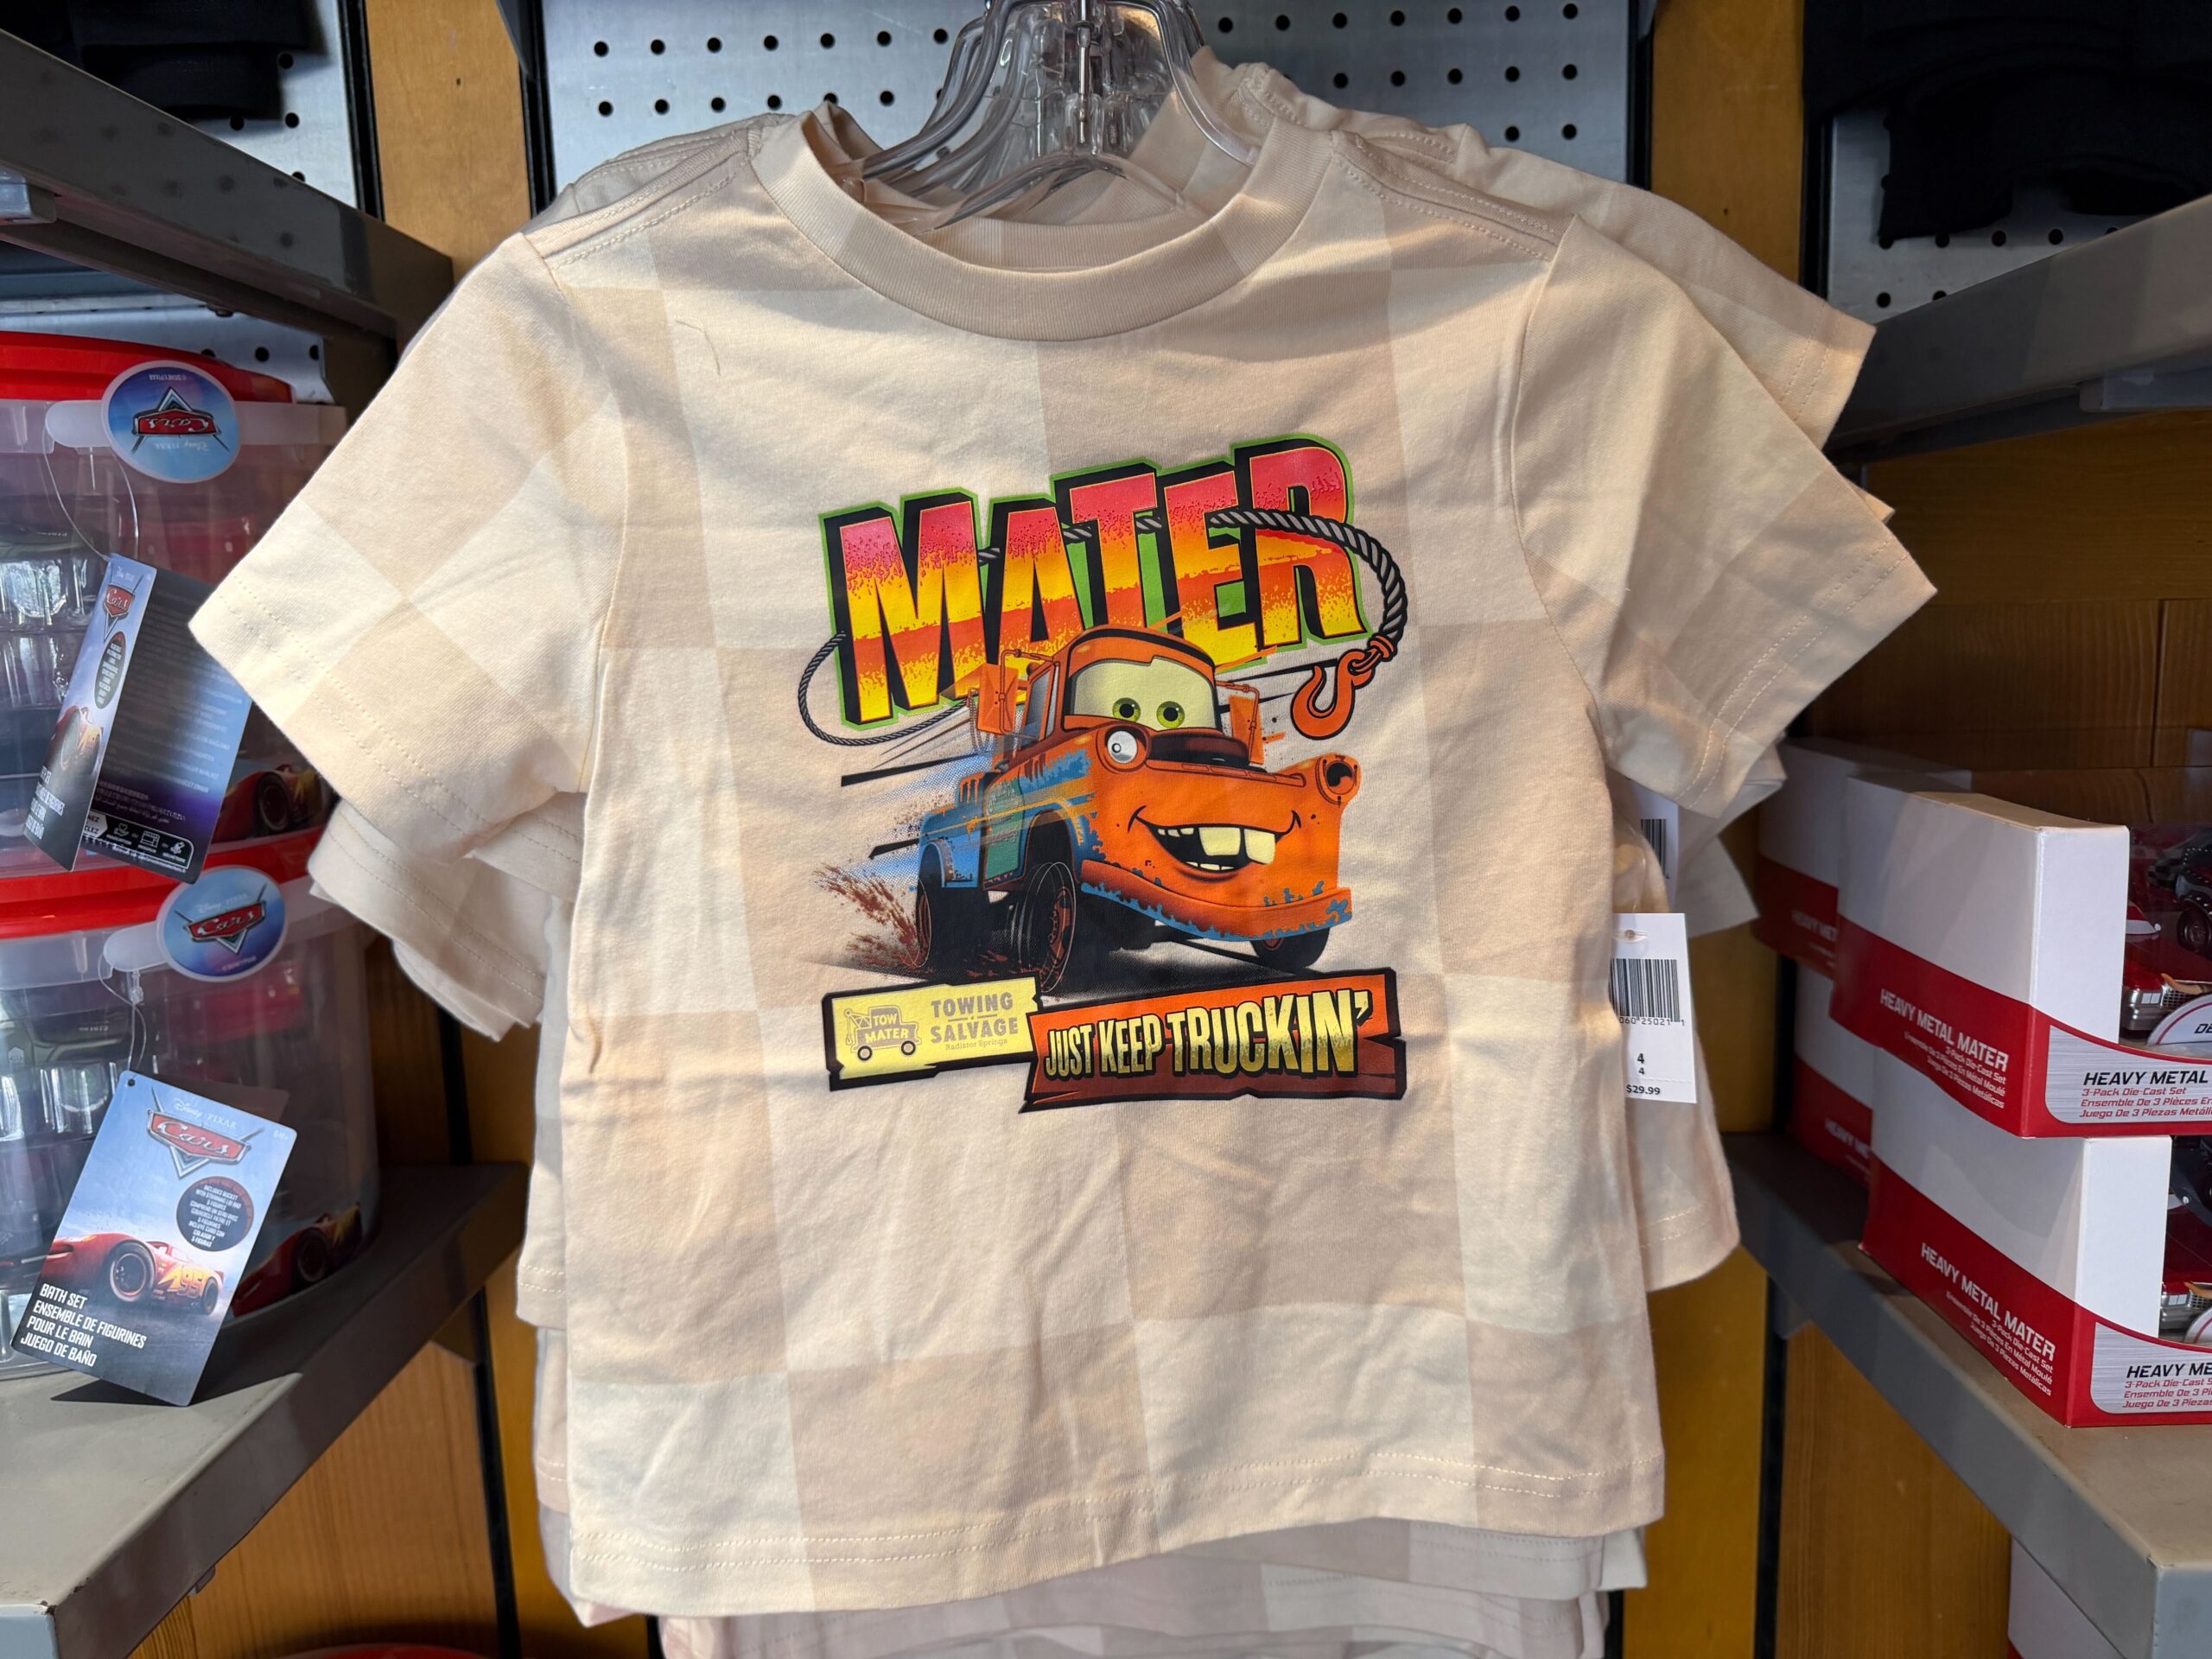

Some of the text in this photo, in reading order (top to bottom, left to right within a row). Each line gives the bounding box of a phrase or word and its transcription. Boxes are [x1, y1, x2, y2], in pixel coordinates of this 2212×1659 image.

[147, 418, 208, 432] Cars
[828, 439, 1367, 726] MATER
[197, 912, 254, 935] Cars
[931, 992, 1013, 1017] TOWING
[873, 1014, 897, 1025] TOW
[931, 1017, 1018, 1044] SALVAGE
[1880, 988, 2009, 1071] HEAVY METAL MATER
[865, 1028, 909, 1044] MATER
[945, 1038, 1007, 1051] Radiator Springs
[1046, 1025, 1095, 1077] JUST
[1099, 1014, 1161, 1074] KEEP
[1637, 1053, 1644, 1064] 4
[1945, 1046, 2005, 1084] 3-Pack Die-Cast Set
[1626, 1084, 1661, 1095] $29.99
[1984, 1080, 2005, 1096] Moulé
[2083, 1071, 2208, 1085] HEAVY METAL
[1973, 1084, 2005, 1109] Metálicas
[2163, 1096, 2198, 1105] Pièces
[174, 1097, 237, 1129] Disney PIXAR
[2079, 1109, 2113, 1119] Juego
[157, 1122, 229, 1155] Cars
[40, 1283, 87, 1310] BATH SET
[1922, 1243, 2056, 1362] HEAVY METAL MATER
[27, 1315, 94, 1349] POUR LE BAIN
[33, 1300, 147, 1349] ENSEMBLE DE FIGURINES
[21, 1332, 97, 1367] JUEGO DE BAÑO
[1992, 1319, 2053, 1373] 3-Pack Die-Cast Set
[2000, 1349, 2019, 1370] Piezas
[2020, 1364, 2051, 1396] Metálicas
[2005, 1342, 2012, 1354] En
[2014, 1348, 2031, 1369] Métal
[2031, 1363, 2052, 1385] Moulé
[2126, 1363, 2185, 1378] HEAVY
[2125, 1380, 2160, 1389] 3-Pack
[2163, 1378, 2204, 1388] Die-Cast
